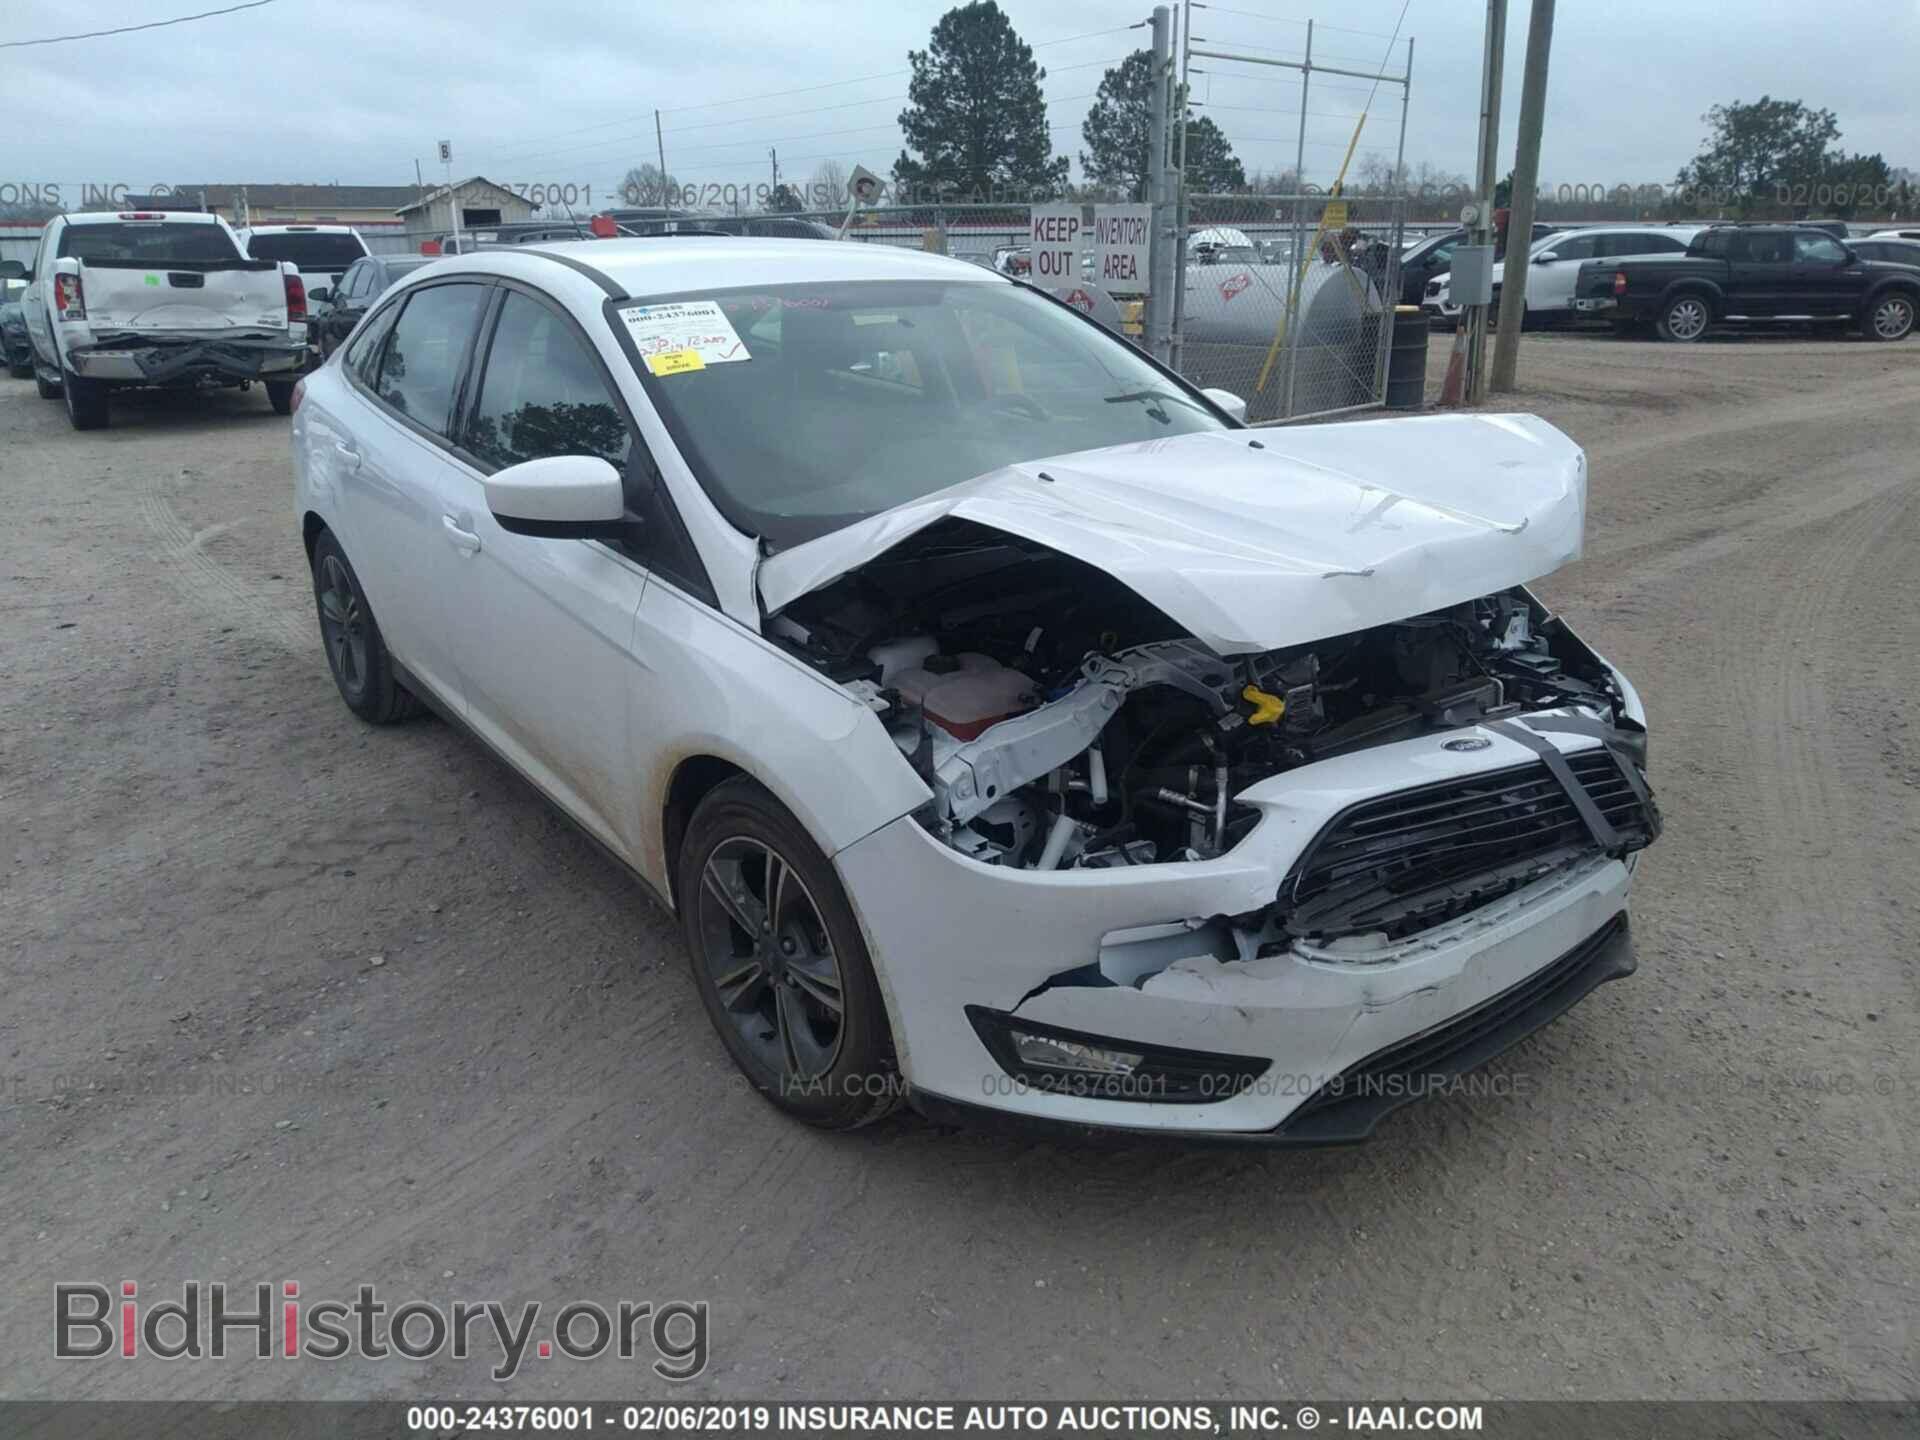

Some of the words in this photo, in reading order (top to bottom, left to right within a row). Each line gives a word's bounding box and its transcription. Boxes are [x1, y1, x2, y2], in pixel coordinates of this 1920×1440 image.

[1034, 217, 1079, 242] KEEP
[1096, 217, 1150, 245] INVENTORY
[1039, 251, 1073, 276] OUT
[1104, 254, 1137, 280] AREA
[628, 309, 716, 324] 000-24376001
